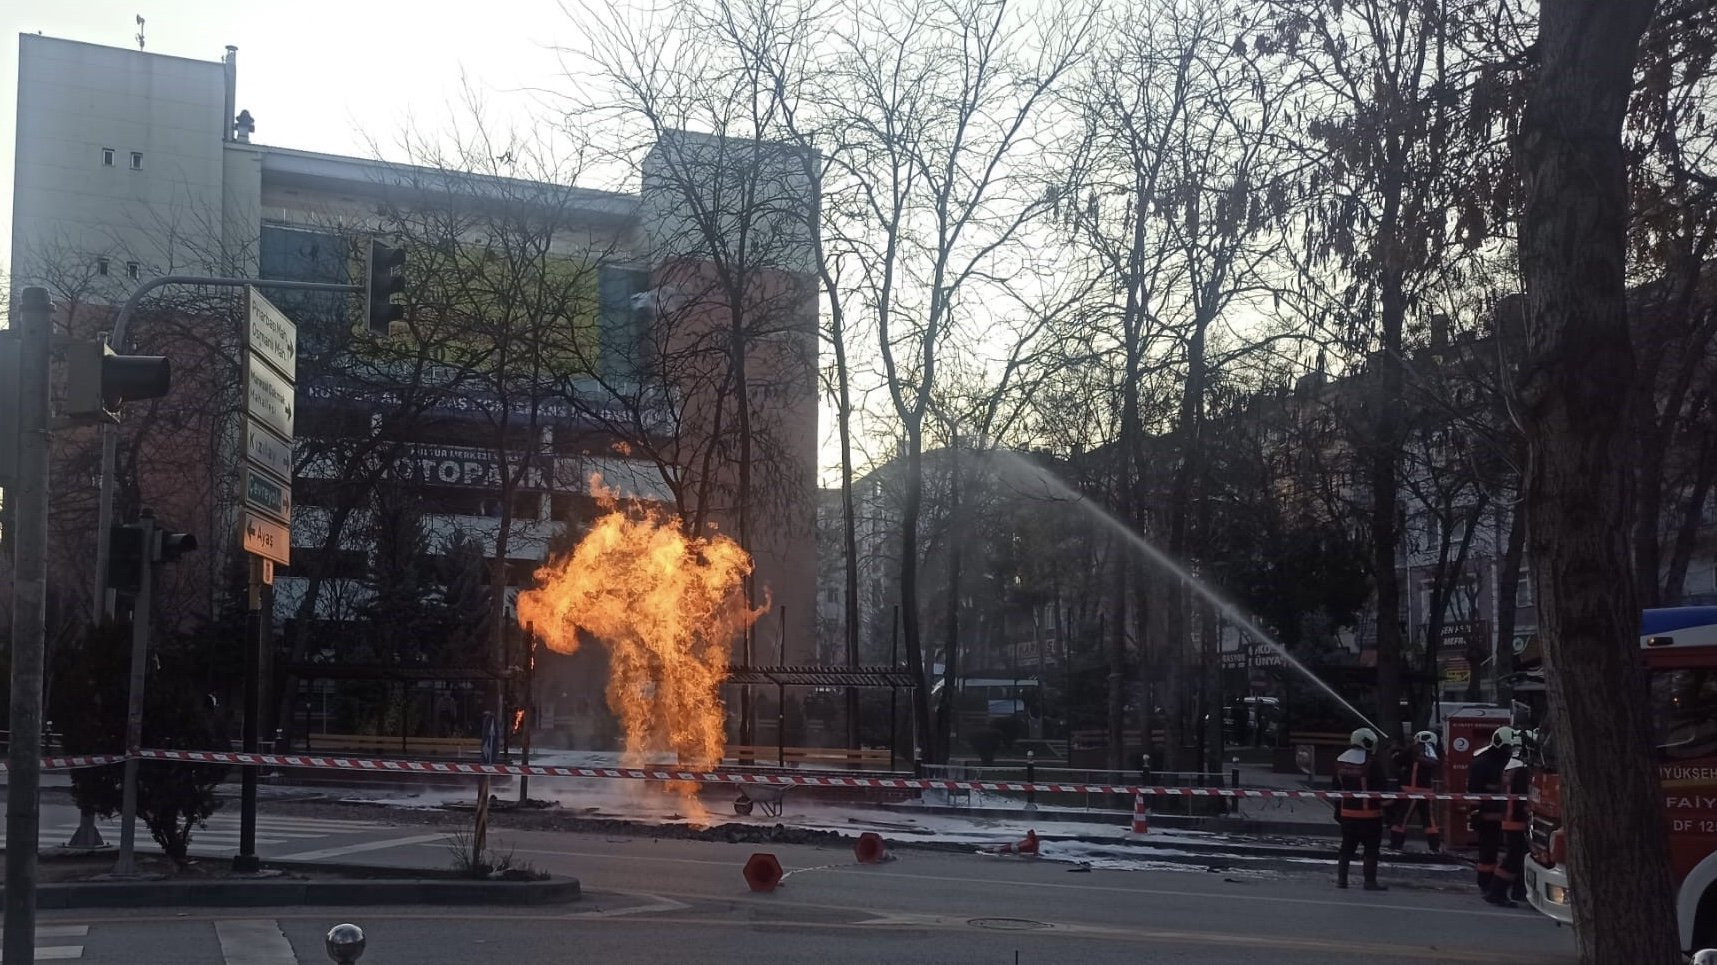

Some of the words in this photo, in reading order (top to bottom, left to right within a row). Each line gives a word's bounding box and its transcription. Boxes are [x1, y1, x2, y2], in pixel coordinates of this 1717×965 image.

[257, 524, 273, 548] Ayaş
[1673, 819, 1693, 831] DF
[1699, 820, 1717, 832] 12
